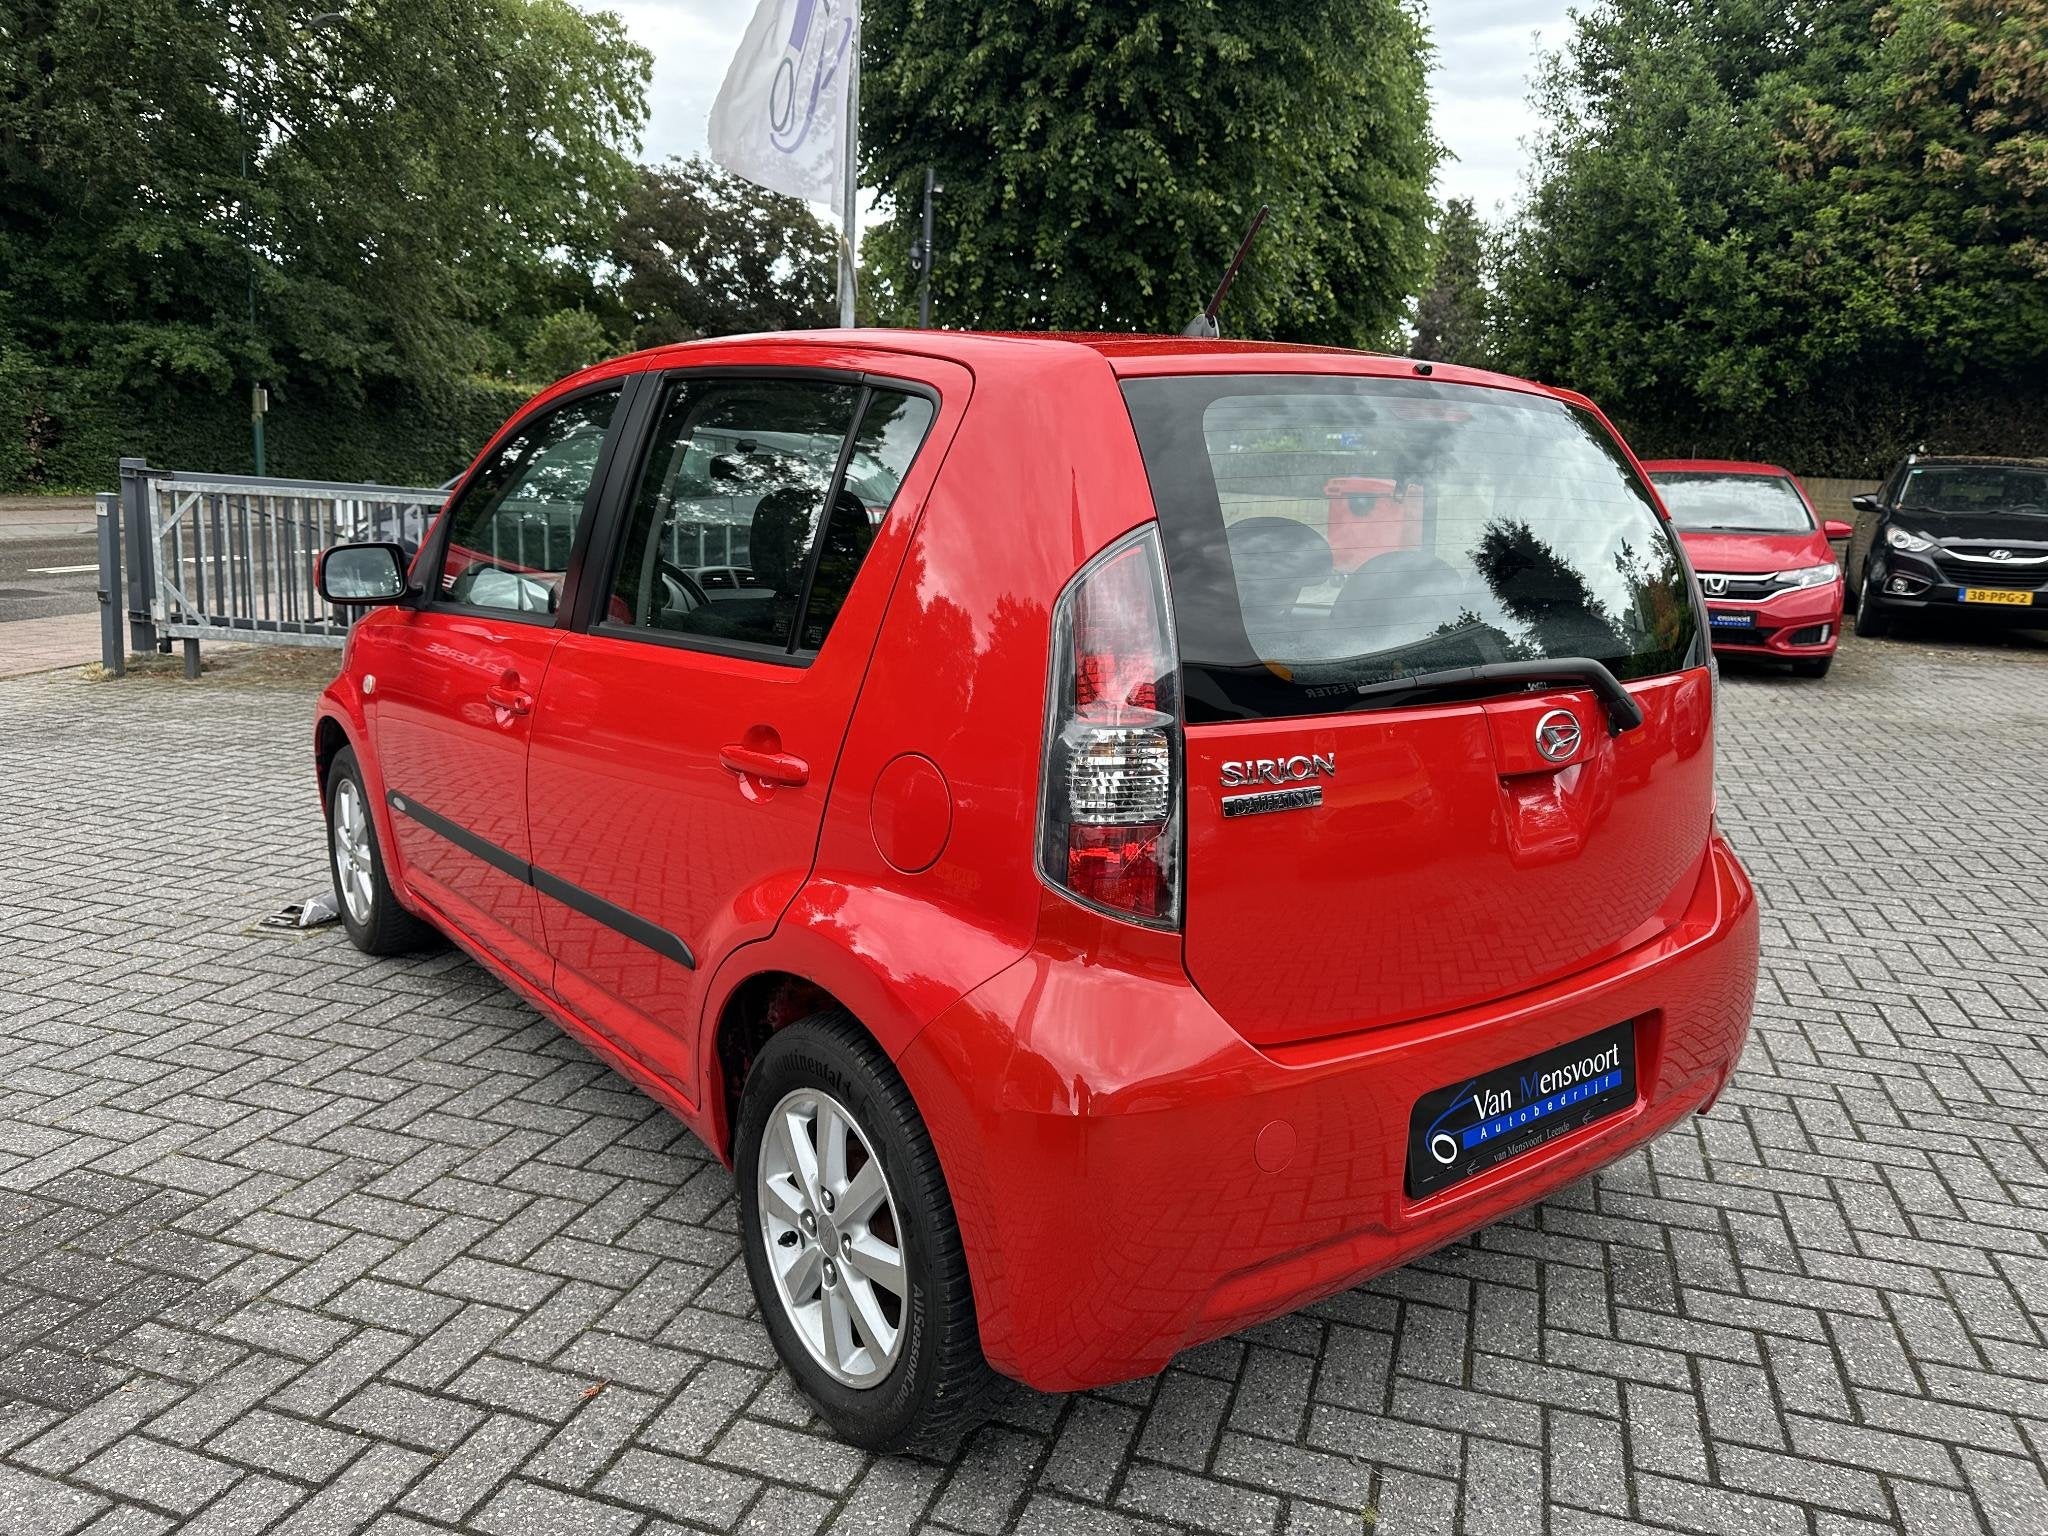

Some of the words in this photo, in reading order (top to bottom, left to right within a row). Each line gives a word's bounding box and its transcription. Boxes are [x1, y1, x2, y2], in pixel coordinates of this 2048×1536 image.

[1968, 590, 2027, 603] 38-PPG-2
[1220, 752, 1335, 787] SIRION
[1234, 789, 1314, 814] DAIHATSU
[769, 1049, 842, 1091] ontinental
[1473, 1089, 1512, 1120] Van
[1520, 1043, 1620, 1103] Mensvoort
[1480, 1076, 1609, 1139] Autobedrijf
